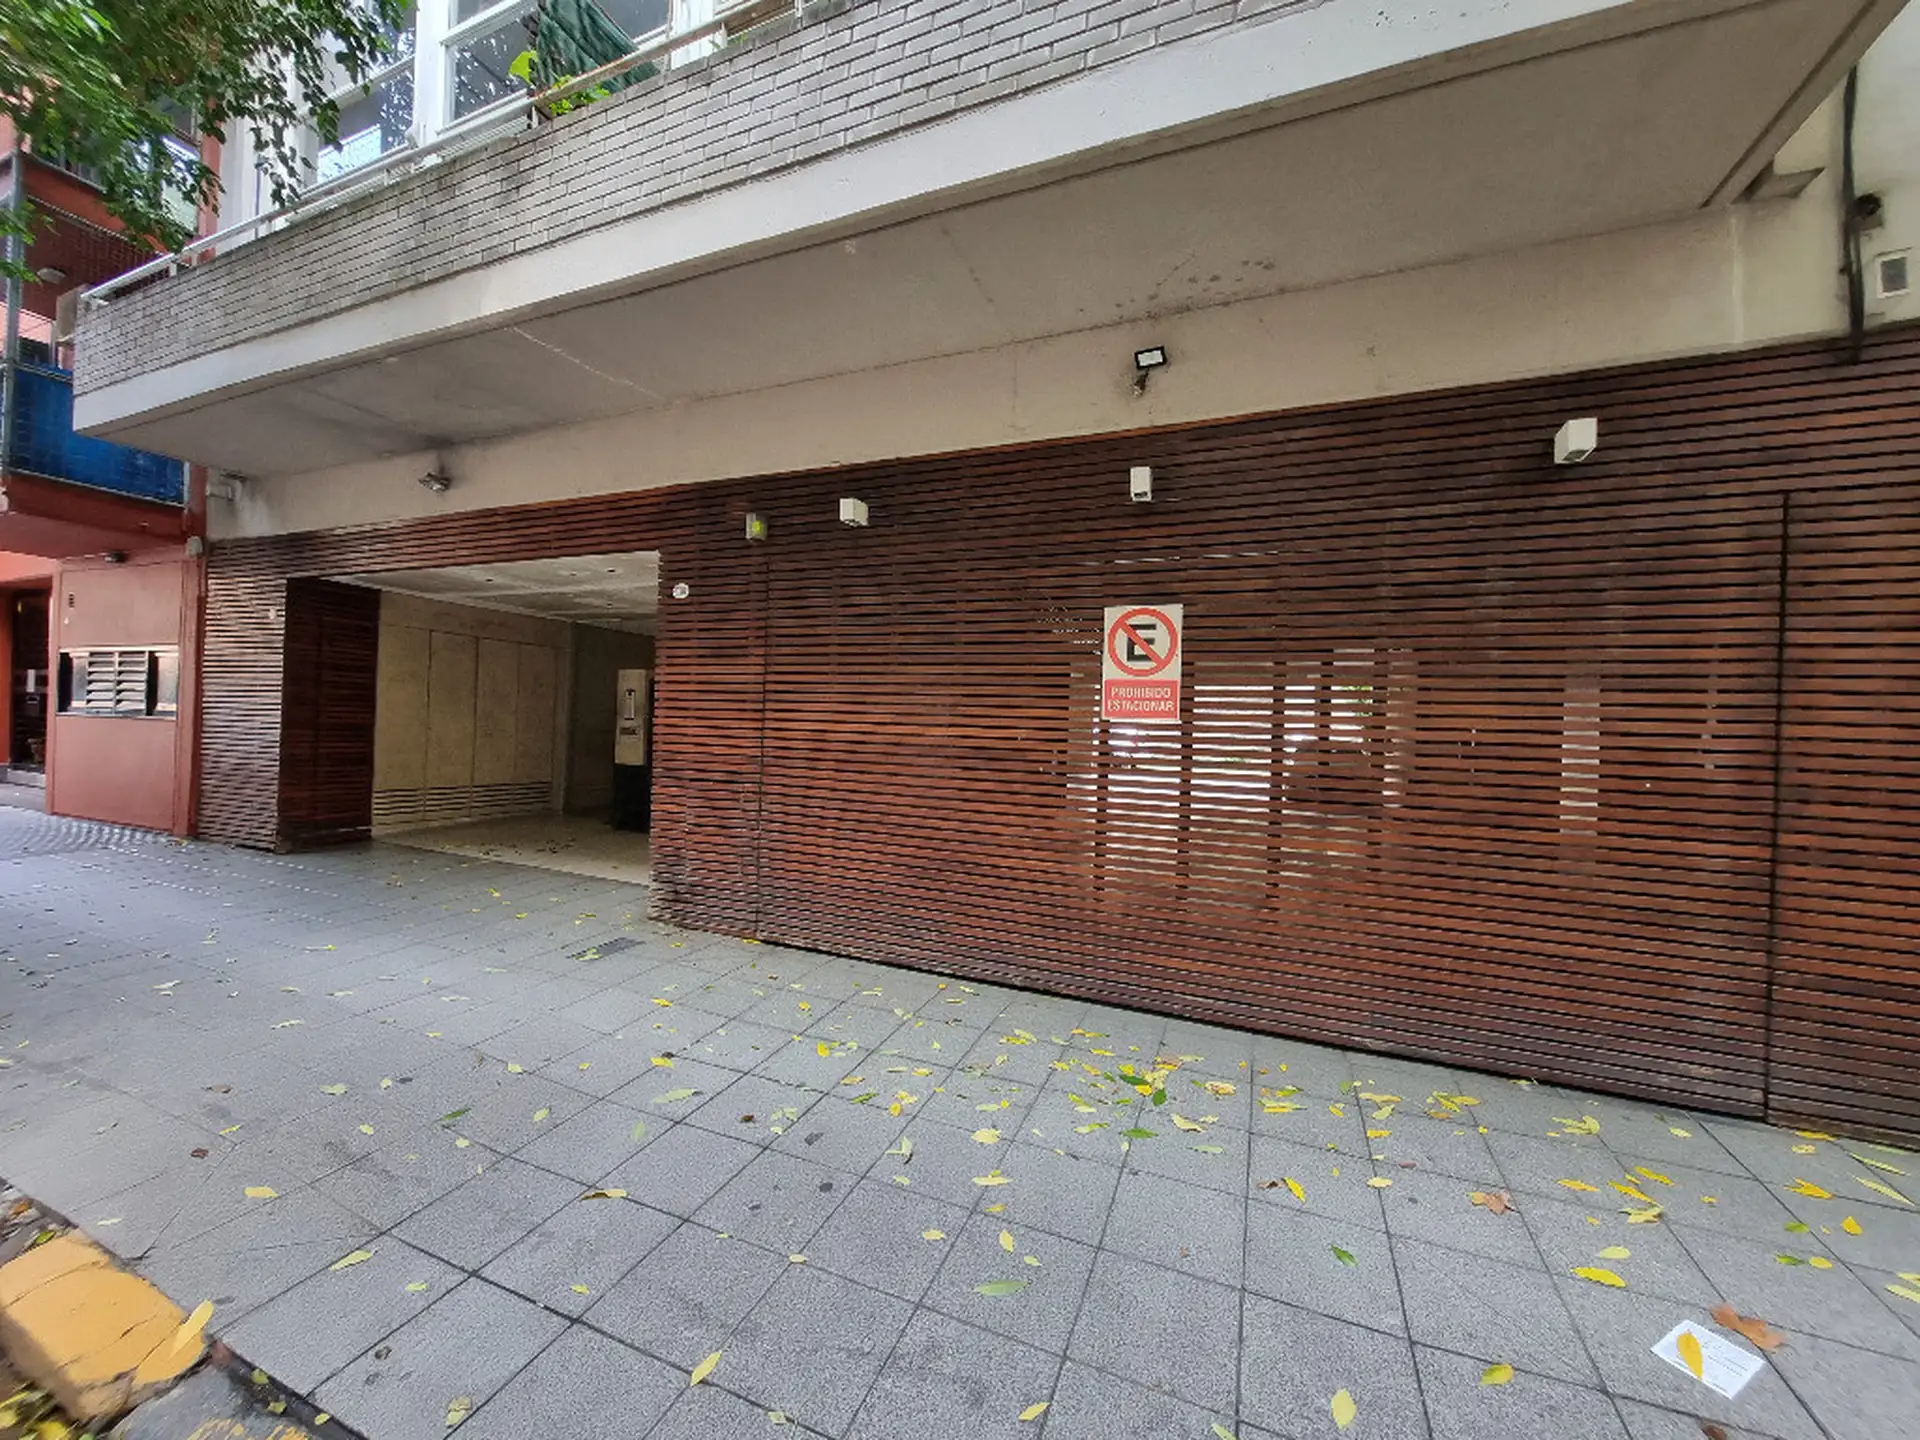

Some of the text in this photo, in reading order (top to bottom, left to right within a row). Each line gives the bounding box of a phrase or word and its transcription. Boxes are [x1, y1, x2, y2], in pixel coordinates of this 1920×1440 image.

[1127, 624, 1157, 661] E
[1111, 686, 1172, 698] PROHIBIDO
[1107, 699, 1175, 712] ESTACIONAR
